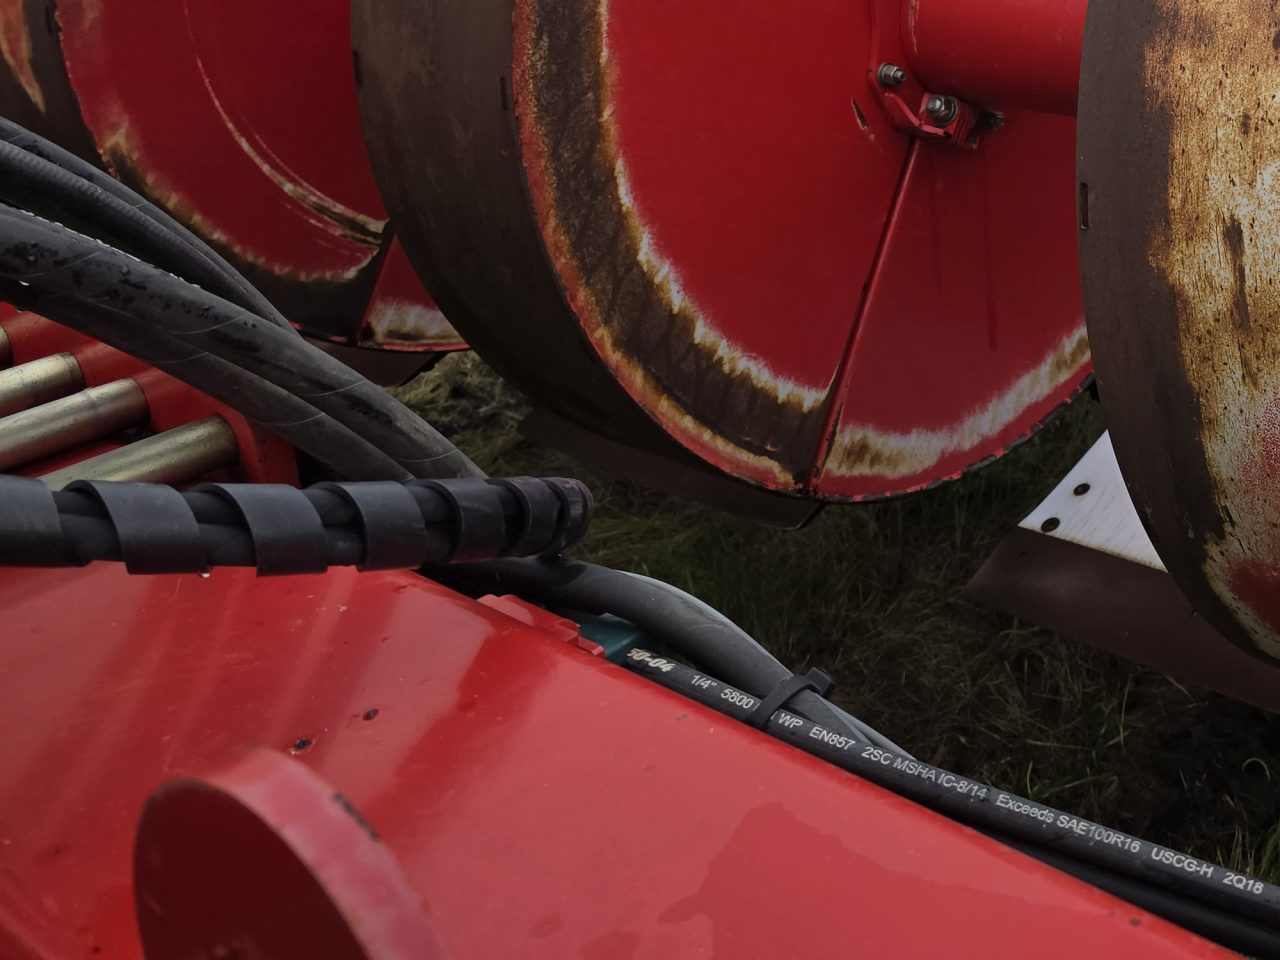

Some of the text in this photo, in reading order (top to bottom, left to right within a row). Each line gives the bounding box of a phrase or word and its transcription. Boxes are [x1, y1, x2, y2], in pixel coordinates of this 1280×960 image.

[691, 674, 717, 690] 1/4"
[720, 688, 755, 709] 5800
[777, 712, 803, 728] WP
[809, 726, 856, 750] EN857
[861, 746, 893, 765] 2SC
[893, 757, 936, 781] MSHA
[935, 773, 988, 800] IC-8/14
[996, 794, 1055, 823] Exceeds
[1057, 815, 1142, 853] SAE100R16
[1151, 847, 1214, 878] USCG-H
[1222, 871, 1265, 894] 2Q18
